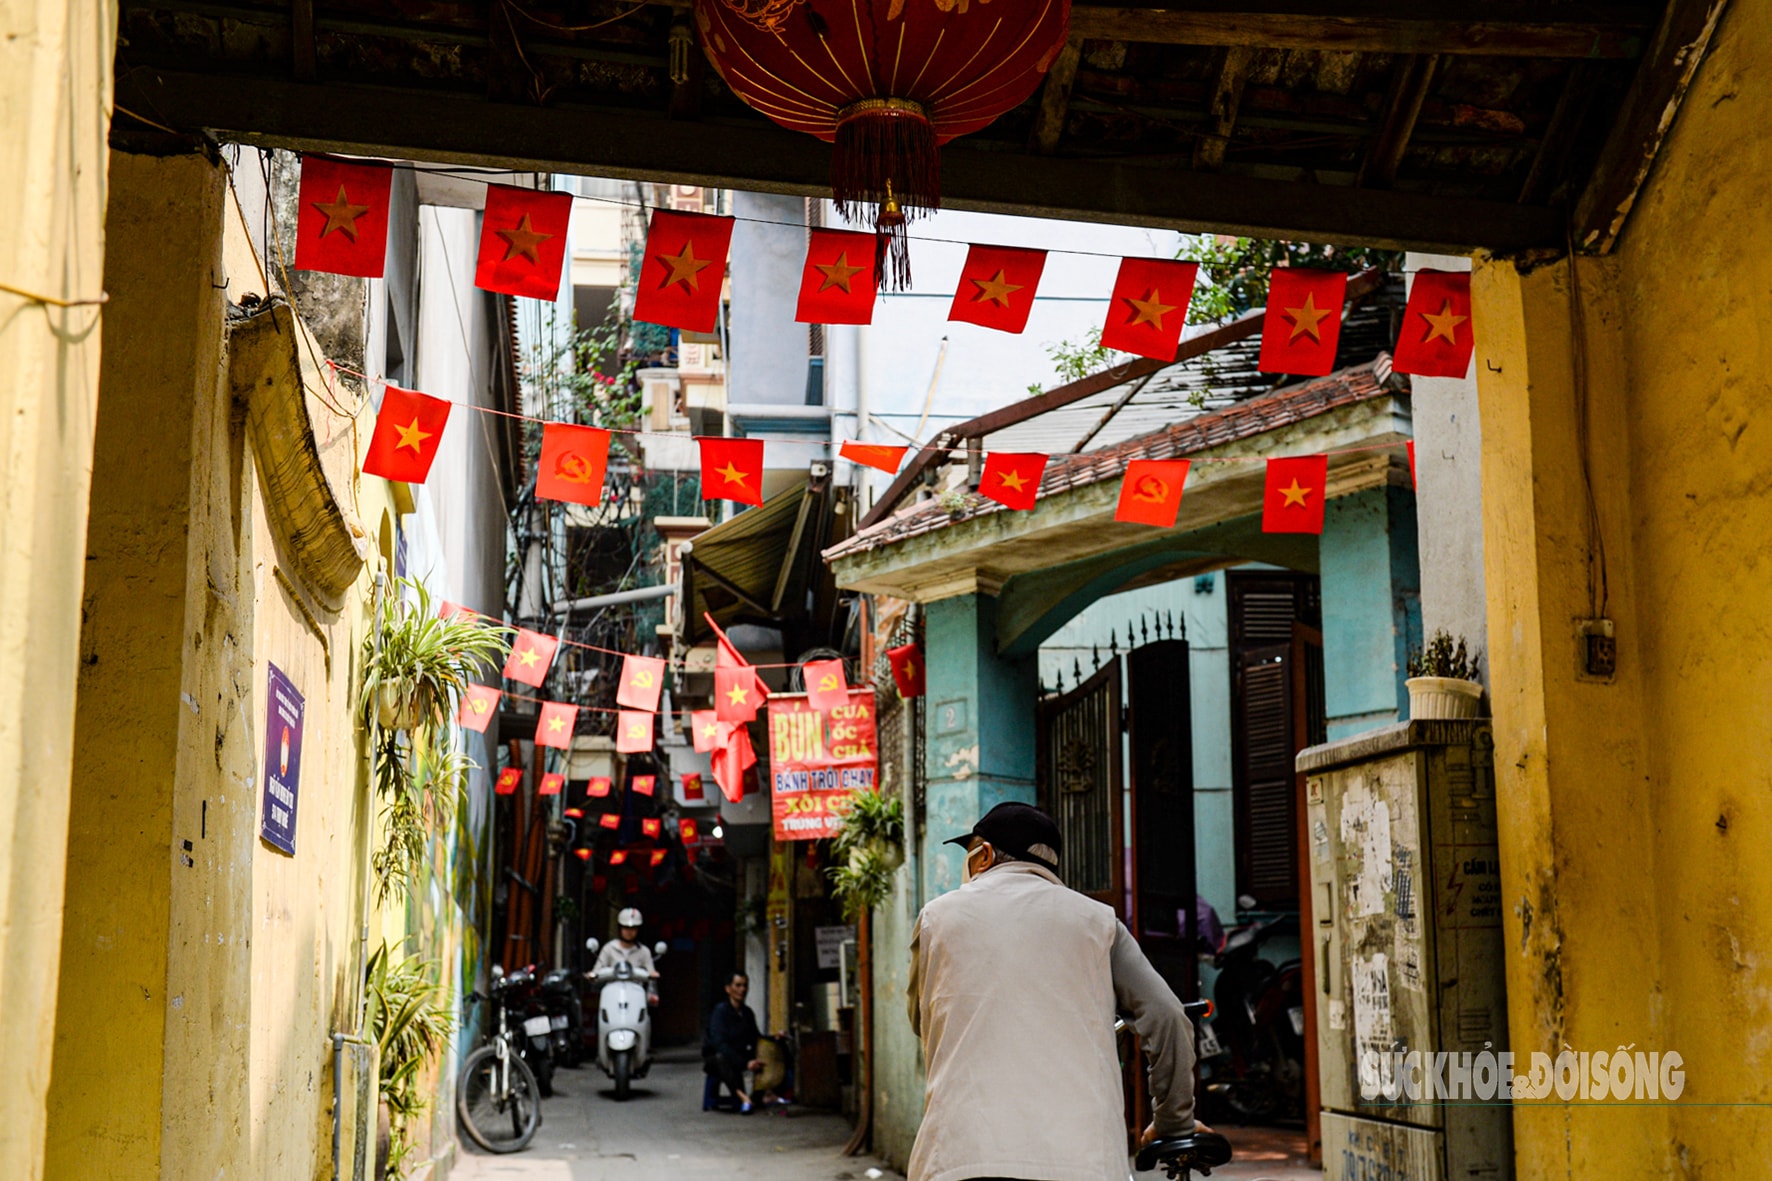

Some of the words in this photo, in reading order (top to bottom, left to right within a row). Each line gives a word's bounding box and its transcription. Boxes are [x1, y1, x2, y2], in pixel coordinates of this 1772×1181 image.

[831, 704, 869, 719] CUA
[774, 701, 822, 762] BÚN
[832, 721, 857, 740] ỐC
[833, 740, 871, 759] CHẢ
[775, 768, 809, 793] BÁNH
[785, 793, 823, 814] XÔI
